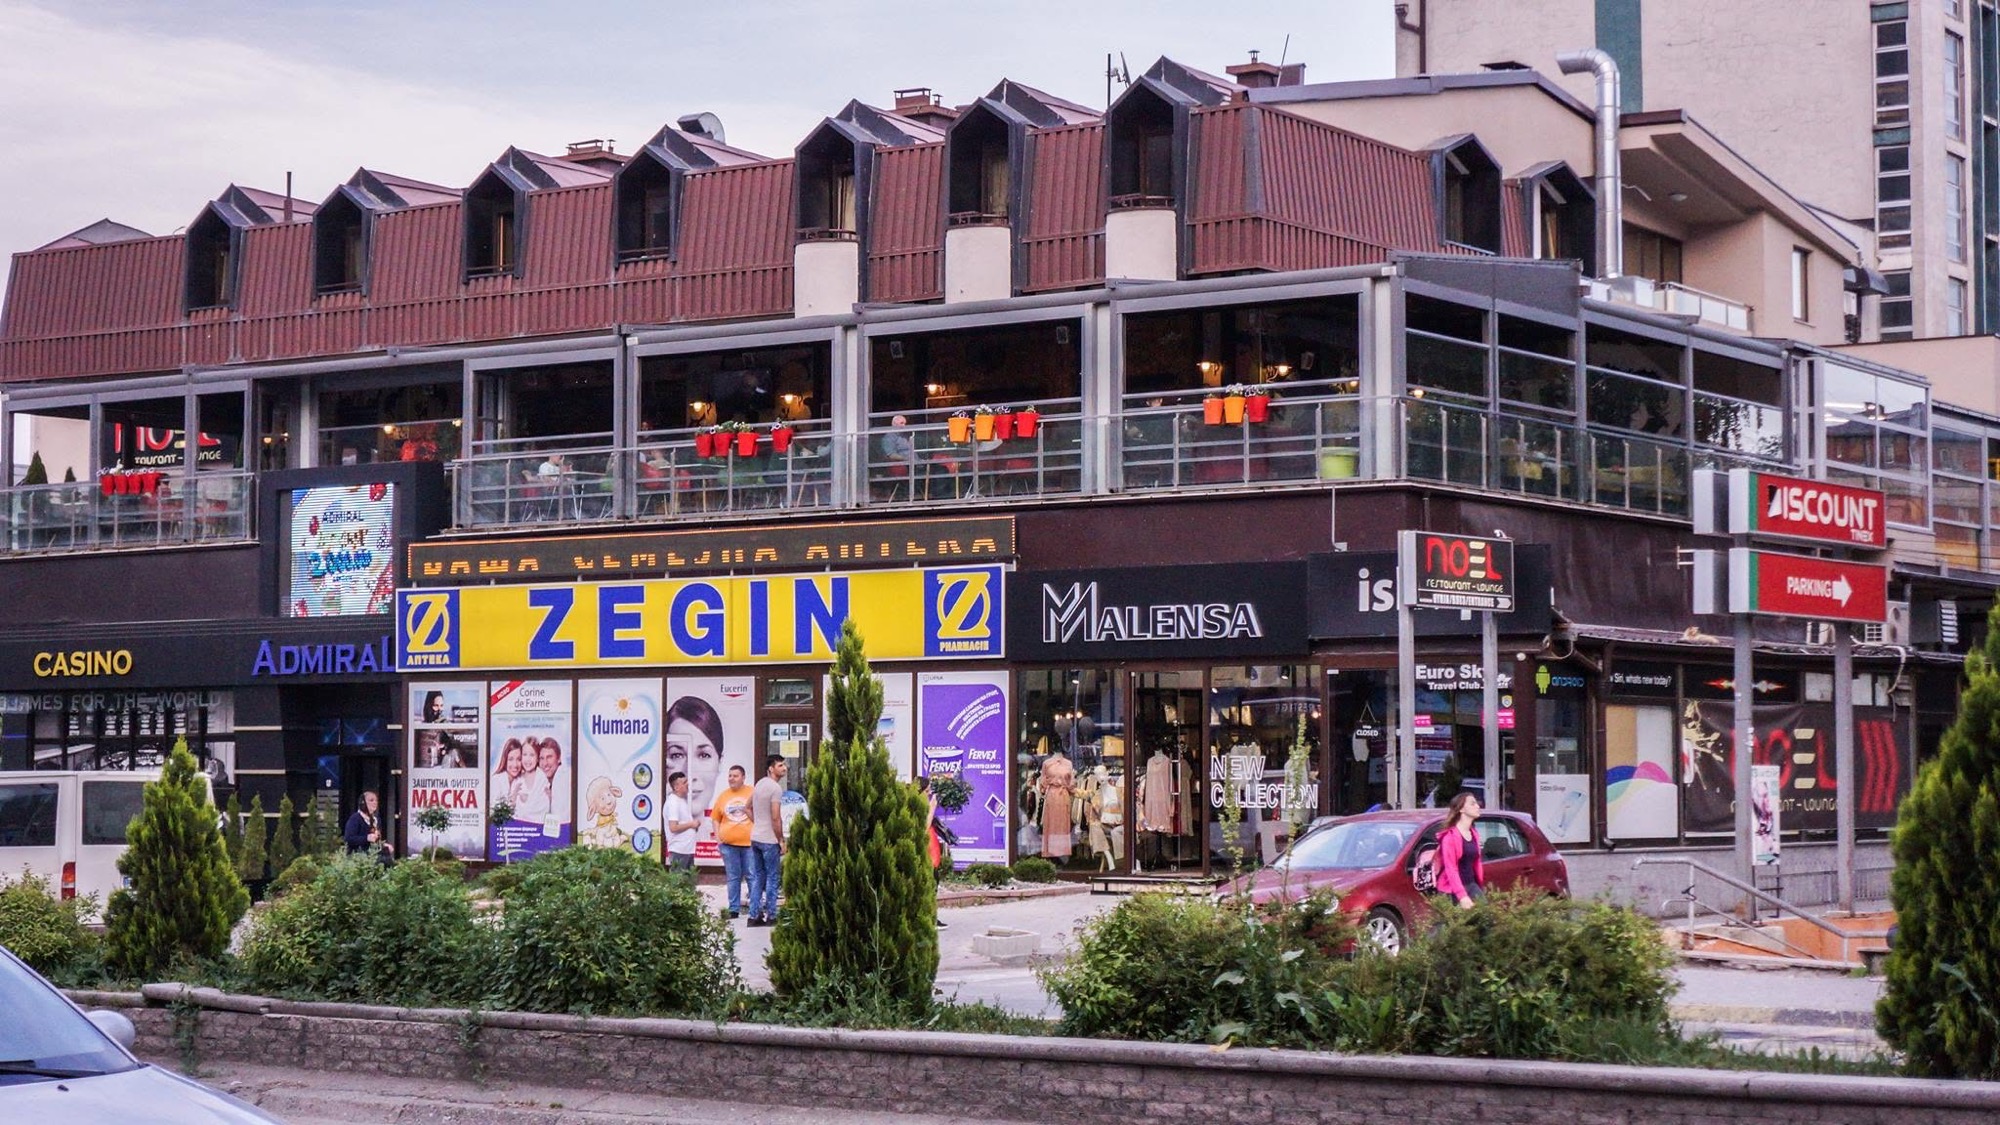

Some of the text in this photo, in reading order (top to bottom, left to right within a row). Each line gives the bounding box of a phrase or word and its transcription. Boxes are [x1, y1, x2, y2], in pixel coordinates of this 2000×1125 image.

[1786, 576, 1832, 598] PARKING
[527, 577, 849, 662] ZEGIN
[1042, 581, 1264, 643] MALENSA
[33, 649, 133, 677] CASINO
[251, 635, 397, 676] ADMIRAL
[406, 654, 450, 665] АПТЕКА
[1415, 665, 1455, 680] Euro
[519, 687, 545, 697] Corine
[720, 684, 747, 694] Eucerin
[1427, 682, 1457, 690] Travel
[514, 698, 551, 708] de Farme
[592, 714, 650, 736] Humana
[1356, 729, 1379, 737] CLOSED
[1210, 755, 1267, 781] NEW
[411, 789, 478, 809] МАСКА
[1210, 783, 1319, 810] CLLECTON
[1803, 799, 1837, 812] LOUNG
